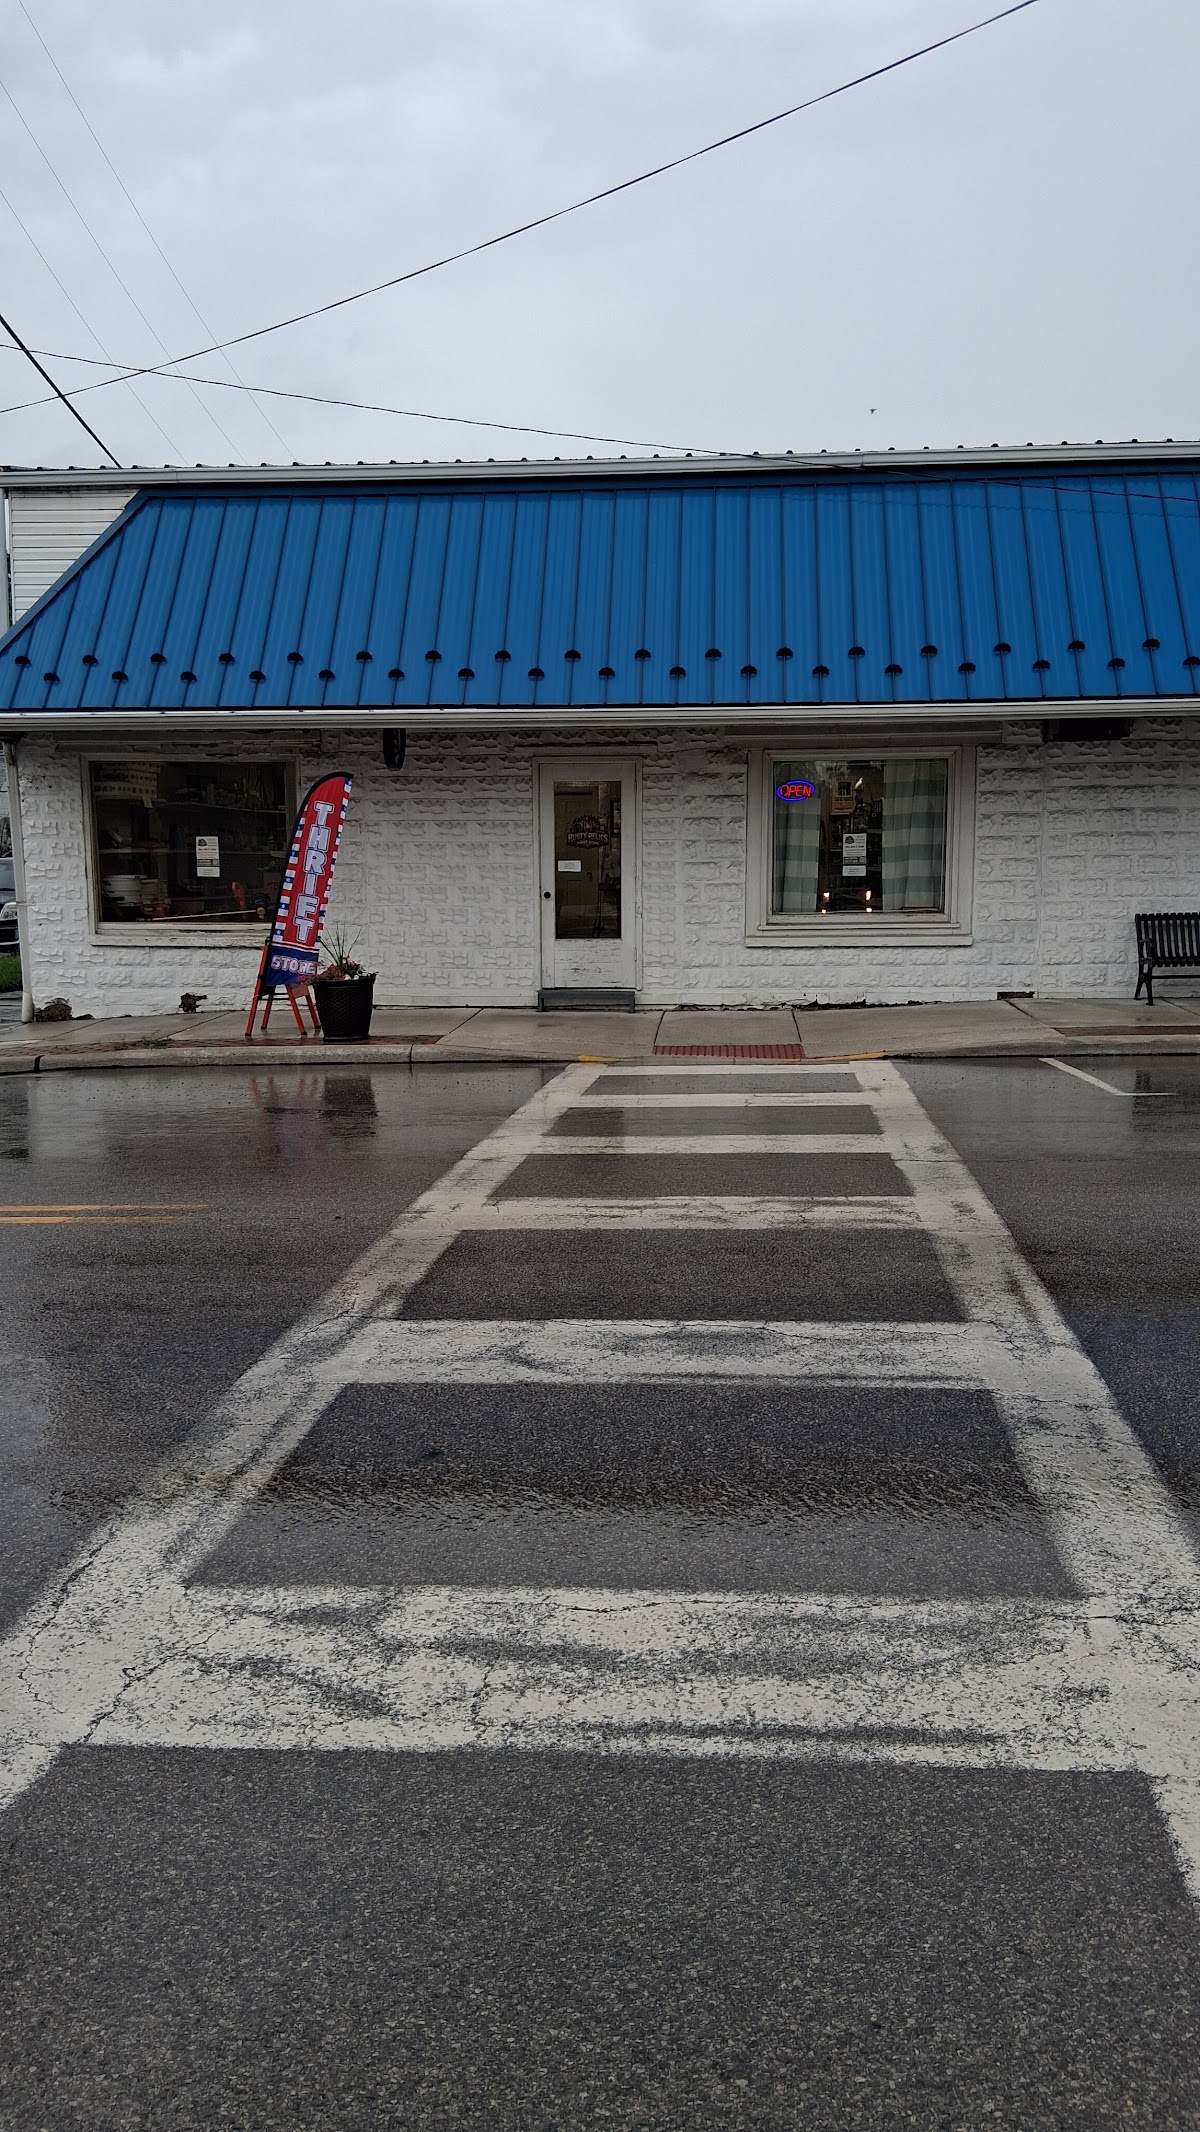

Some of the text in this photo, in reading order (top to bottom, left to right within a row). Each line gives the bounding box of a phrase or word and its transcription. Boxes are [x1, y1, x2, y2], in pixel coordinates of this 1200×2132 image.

[780, 784, 812, 798] OPEN
[567, 832, 588, 842] RUSTY
[588, 832, 608, 843] RELICS
[294, 801, 334, 942] THRIFT
[271, 953, 317, 975] STORE
